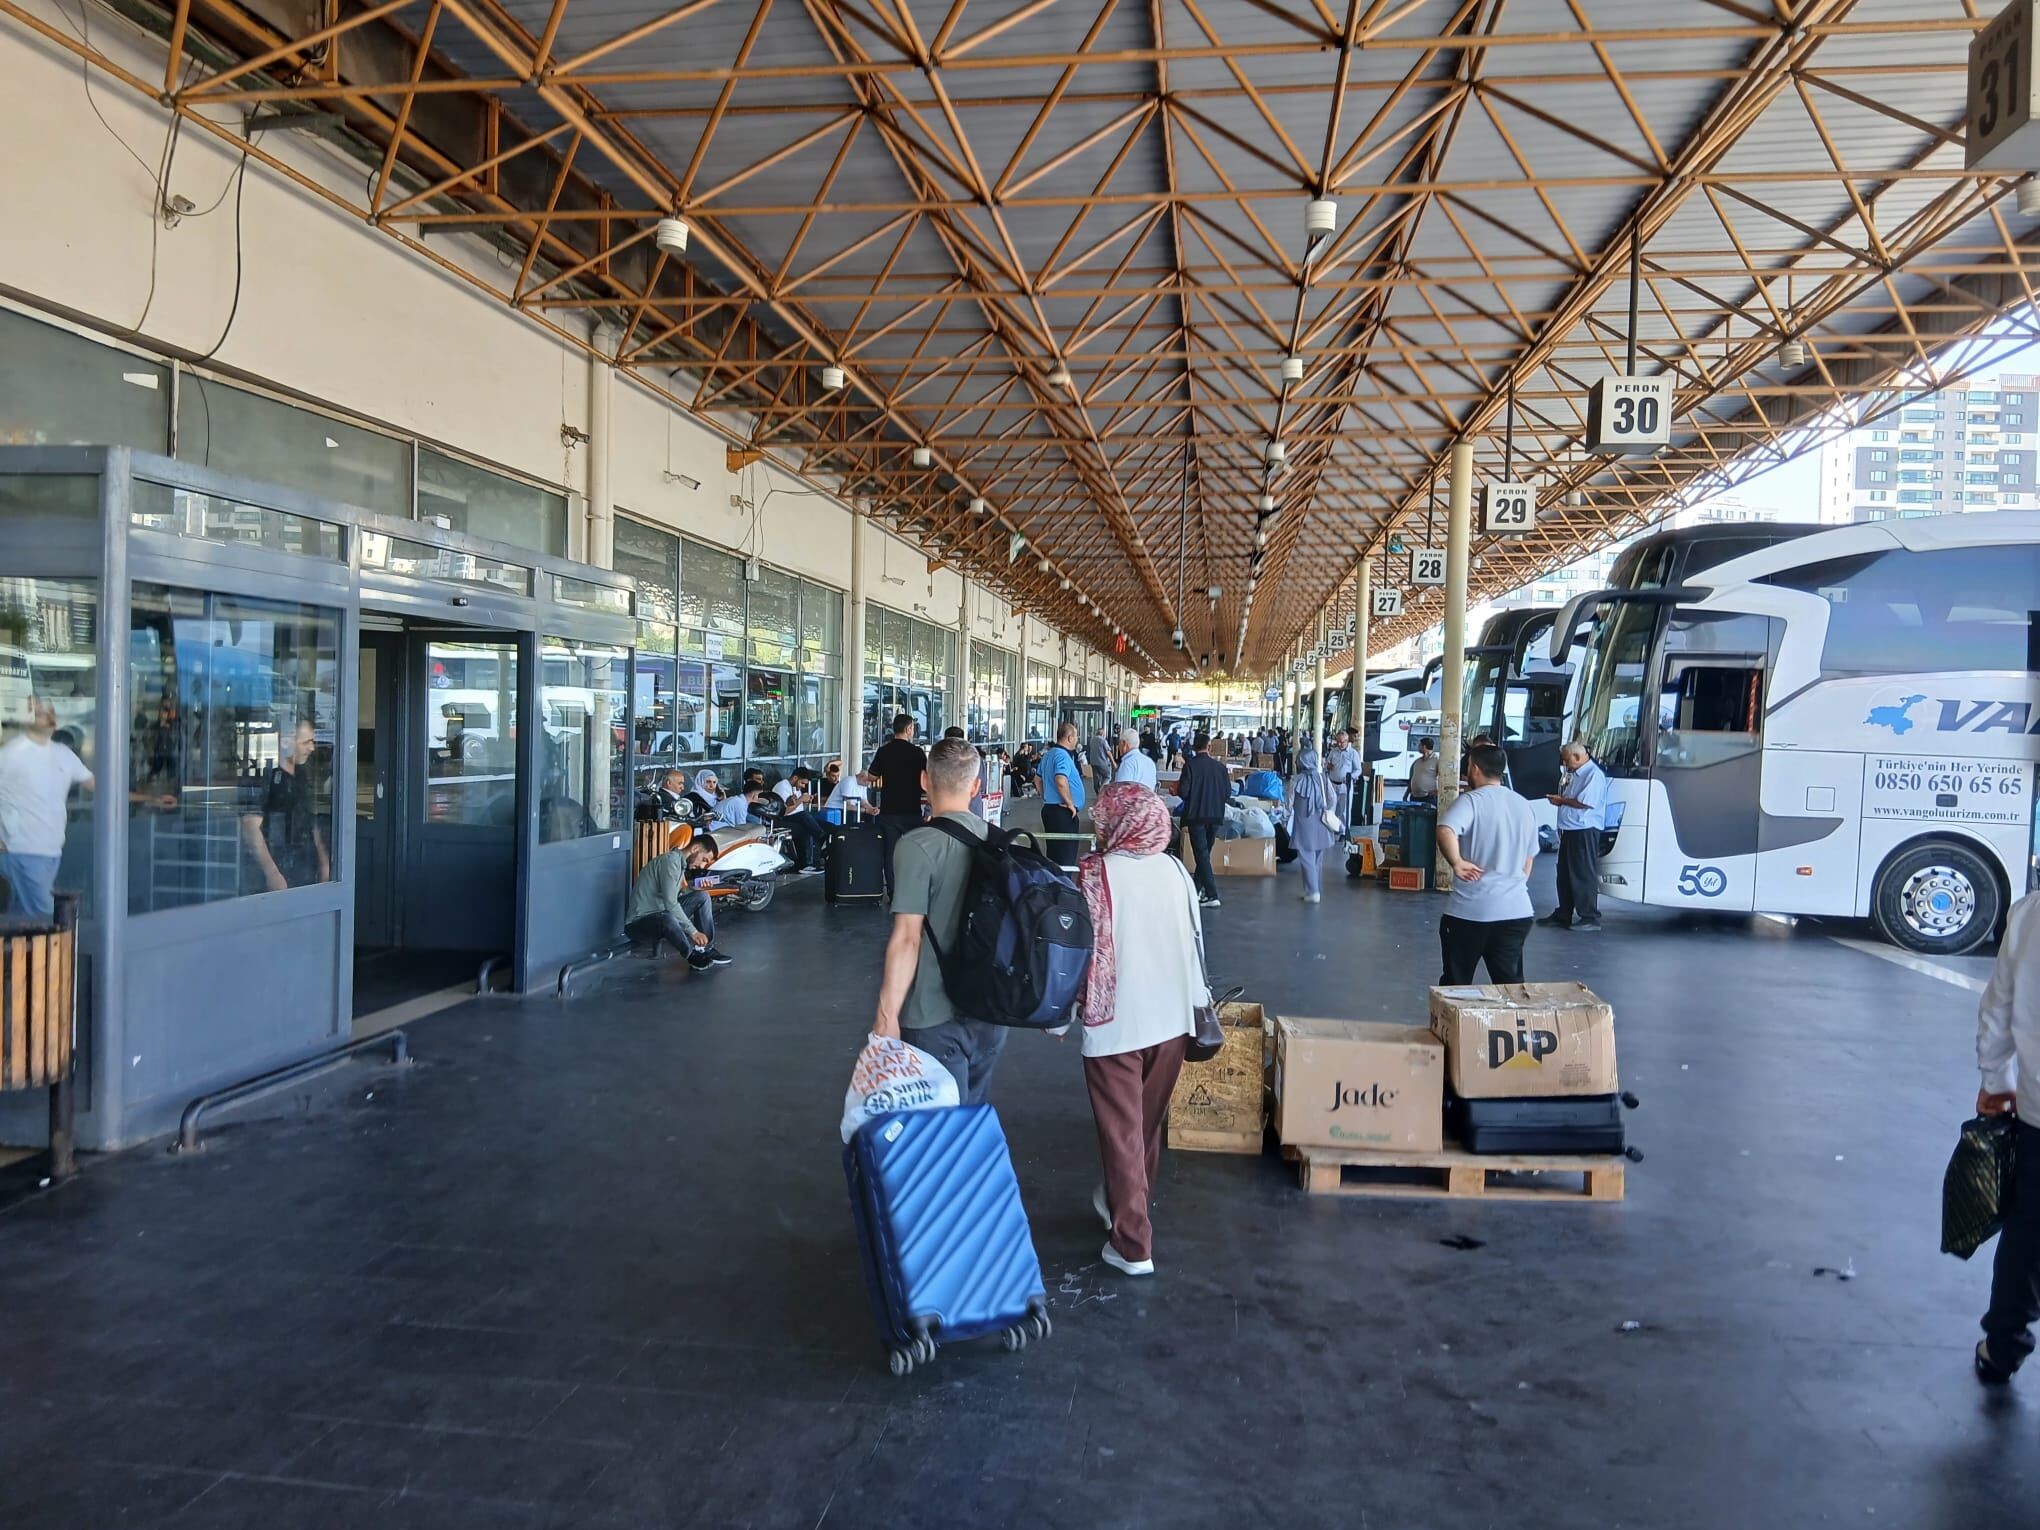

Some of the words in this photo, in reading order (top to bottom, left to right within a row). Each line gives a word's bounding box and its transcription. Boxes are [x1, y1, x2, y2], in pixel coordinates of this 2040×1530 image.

[1979, 38, 2019, 138] 31
[1615, 384, 1660, 393] PERON
[1612, 397, 1659, 434] 30
[1494, 498, 1527, 524] 29
[1418, 559, 1441, 578] 28
[1378, 597, 1396, 611] 27
[1349, 620, 1356, 633] 2
[1331, 635, 1344, 646] 25
[1317, 646, 1329, 656] 24
[1294, 661, 1305, 670] 22
[1935, 698, 2040, 735] VA
[1876, 759, 1946, 773] Türkiye'nin
[1951, 762, 1973, 773] Her
[1977, 763, 2023, 775] Yerinde
[1875, 772, 1921, 791] 0850
[1927, 774, 1962, 792] 650
[1969, 776, 1992, 794] 65
[1998, 777, 2022, 795] 65
[1873, 806, 2021, 823] www.vangoluturizm.com.tr
[1677, 864, 1727, 897] 50
[893, 1080, 931, 1094] SIFIR
[899, 1091, 934, 1109] ATIK
[1326, 1081, 1395, 1112] Jade
